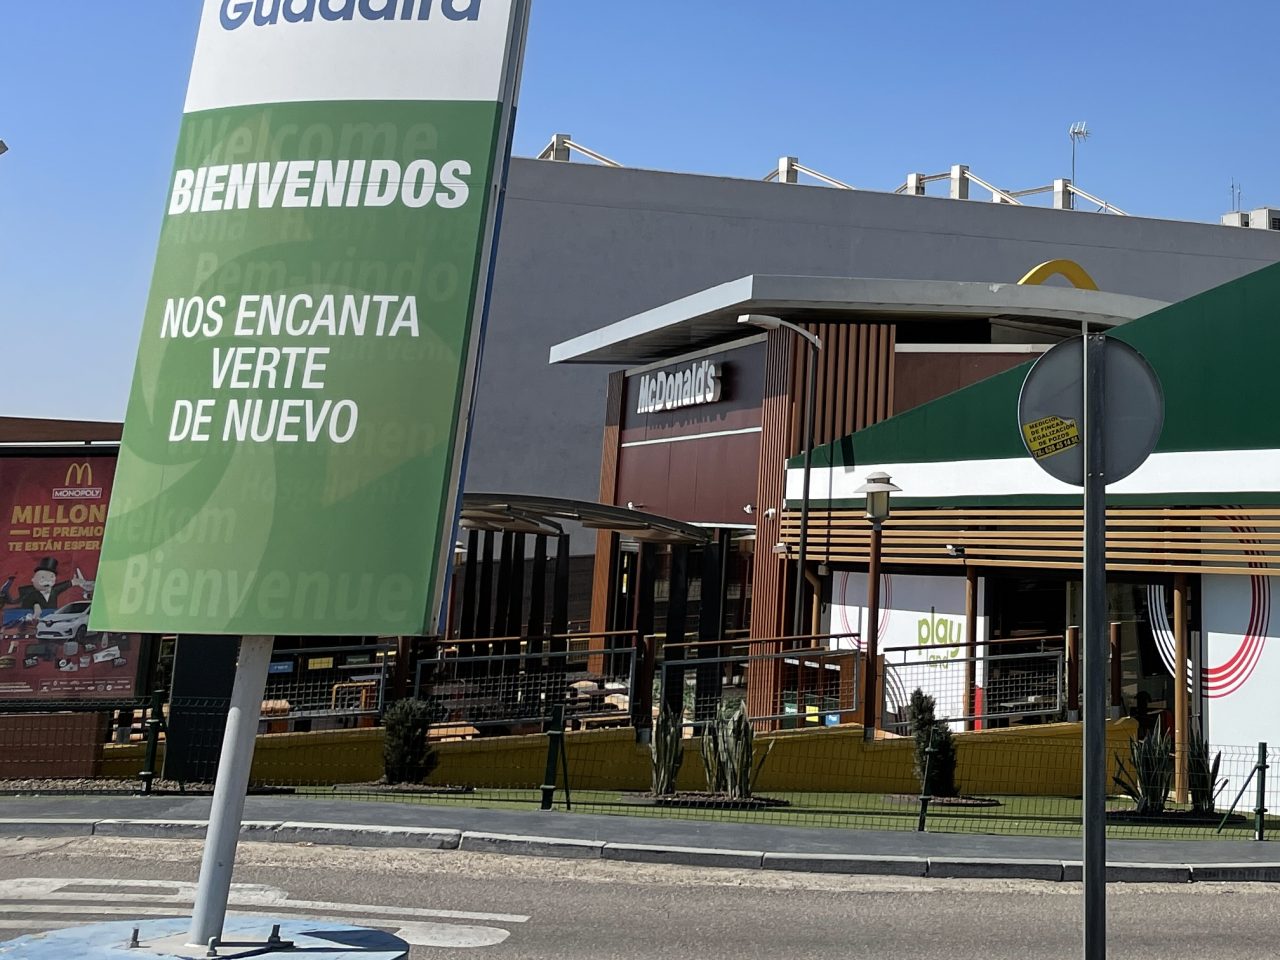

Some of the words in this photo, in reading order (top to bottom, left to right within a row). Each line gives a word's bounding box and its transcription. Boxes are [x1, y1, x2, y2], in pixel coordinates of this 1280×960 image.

[184, 108, 437, 165] Welcome
[168, 160, 471, 215] BIENVENIDOS
[160, 295, 224, 339] NOS
[235, 294, 420, 338] ENCANTA
[212, 347, 331, 390] VERTE
[637, 360, 717, 414] McDonald's
[169, 400, 212, 442] DE
[222, 399, 359, 444] NUEVO
[1049, 432, 1070, 442] POZOS
[11, 504, 106, 524] MILLON
[54, 489, 100, 497] MONOPOLY
[8, 542, 23, 551] TE
[25, 539, 62, 551] ESTÁN
[64, 540, 100, 551] ESPER
[33, 527, 50, 538] DE
[53, 526, 104, 537] PREMIO
[119, 556, 413, 622] Bienvenue
[918, 606, 961, 657] play
